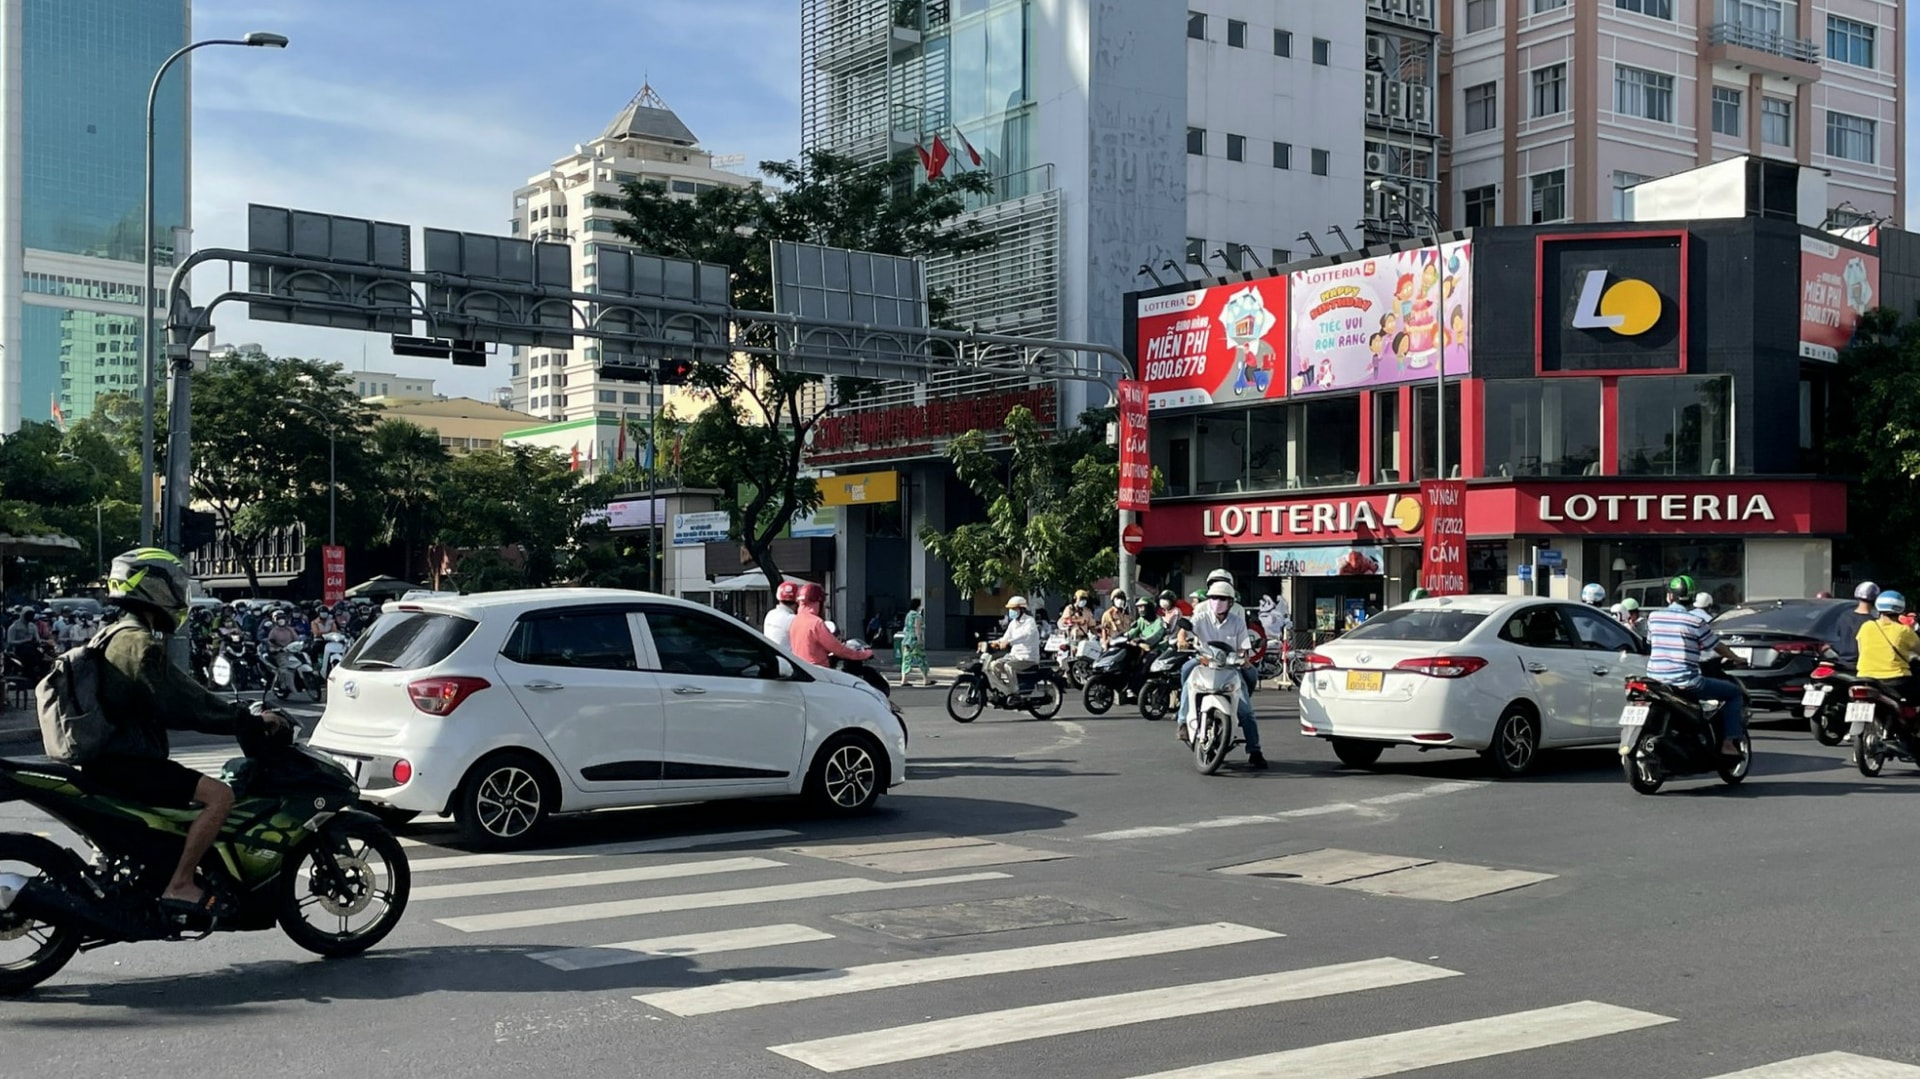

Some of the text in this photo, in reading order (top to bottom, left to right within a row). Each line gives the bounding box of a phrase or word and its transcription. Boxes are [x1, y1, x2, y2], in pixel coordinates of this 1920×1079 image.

[1307, 267, 1361, 285] LOTTERIA
[1320, 285, 1361, 302] HAPPY
[1144, 298, 1185, 312] LOTTERIA
[1309, 296, 1372, 321] BIRTHDAY
[1345, 317, 1363, 330] VUI
[1146, 324, 1212, 360] MIỄN PHÍ
[1144, 355, 1207, 381] 1900.6778
[1125, 433, 1147, 454] CẤM
[1428, 485, 1459, 505] TỪ NGÀY
[1539, 493, 1775, 522] LOTTERIA
[1203, 500, 1379, 538] LOTTERIA
[1430, 540, 1459, 562] CẤM
[1440, 571, 1464, 591] THÔNG
